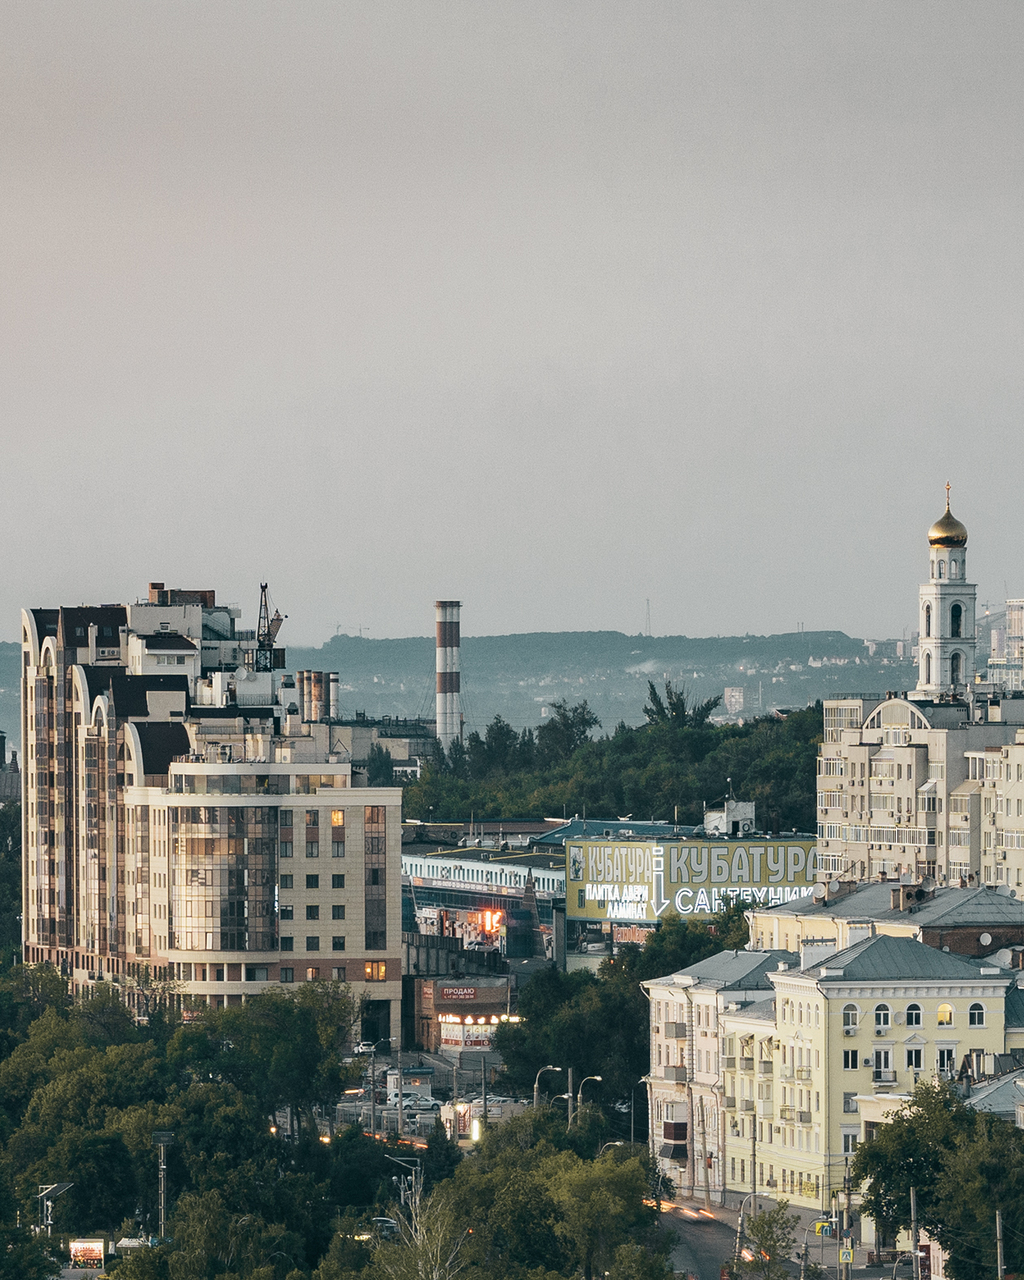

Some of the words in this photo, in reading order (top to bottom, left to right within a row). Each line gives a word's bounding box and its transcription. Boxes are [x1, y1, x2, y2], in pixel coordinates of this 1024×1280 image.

[588, 846, 652, 883] КУБАТУРА
[670, 846, 817, 883] КУБАТУРА
[585, 883, 621, 901] ПЛИТКА
[622, 884, 649, 903] ДВЕРИ
[607, 902, 648, 919] ЛАМИНАТ
